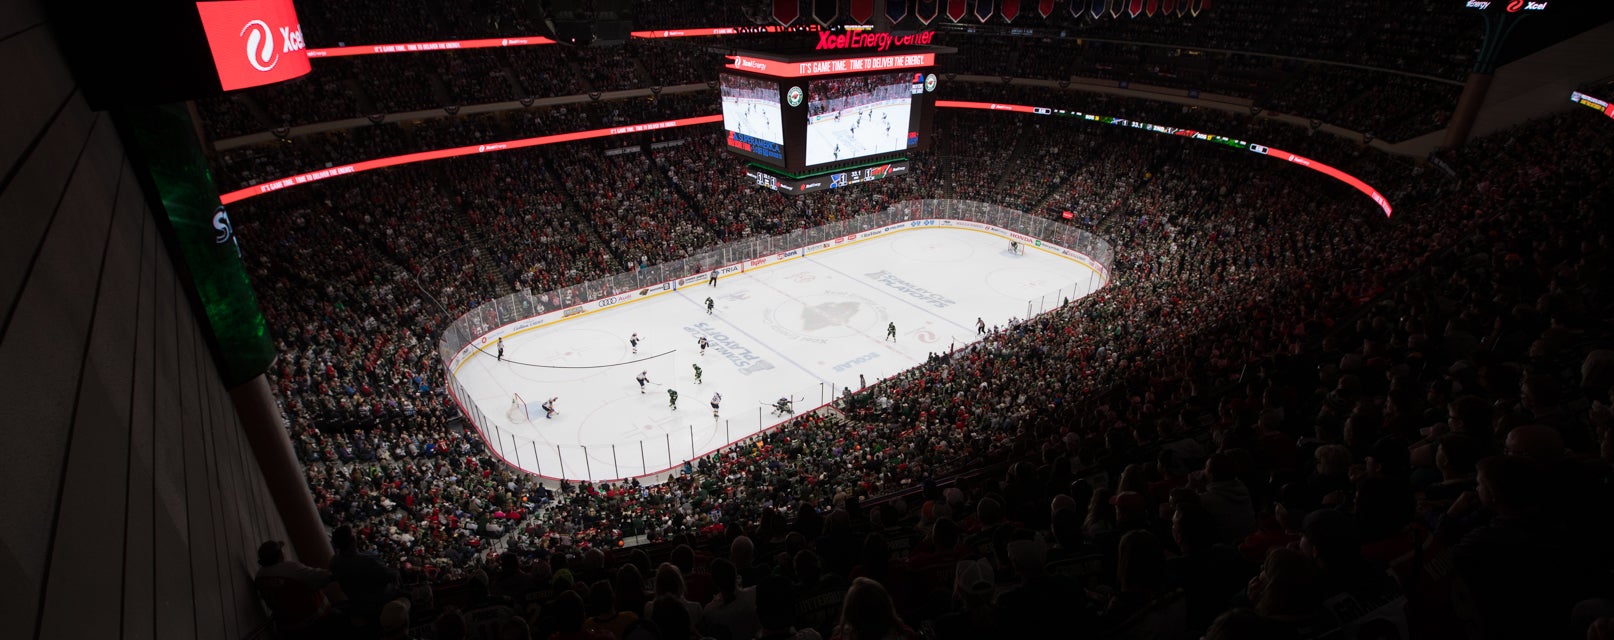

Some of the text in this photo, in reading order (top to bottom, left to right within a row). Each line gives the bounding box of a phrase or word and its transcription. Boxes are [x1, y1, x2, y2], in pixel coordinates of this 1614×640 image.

[1524, 2, 1548, 10] Xcel
[816, 30, 852, 50] Xcel
[850, 30, 894, 51] Energy
[800, 62, 812, 74] IT'S
[813, 61, 831, 72] GAME
[832, 60, 847, 71] TIME.
[850, 58, 863, 70] TIME
[865, 58, 872, 68] TO
[872, 56, 894, 68] DELIVER
[894, 56, 904, 66] THE
[1010, 233, 1033, 244] HONDA
[694, 322, 760, 360] PLAYOFFS
